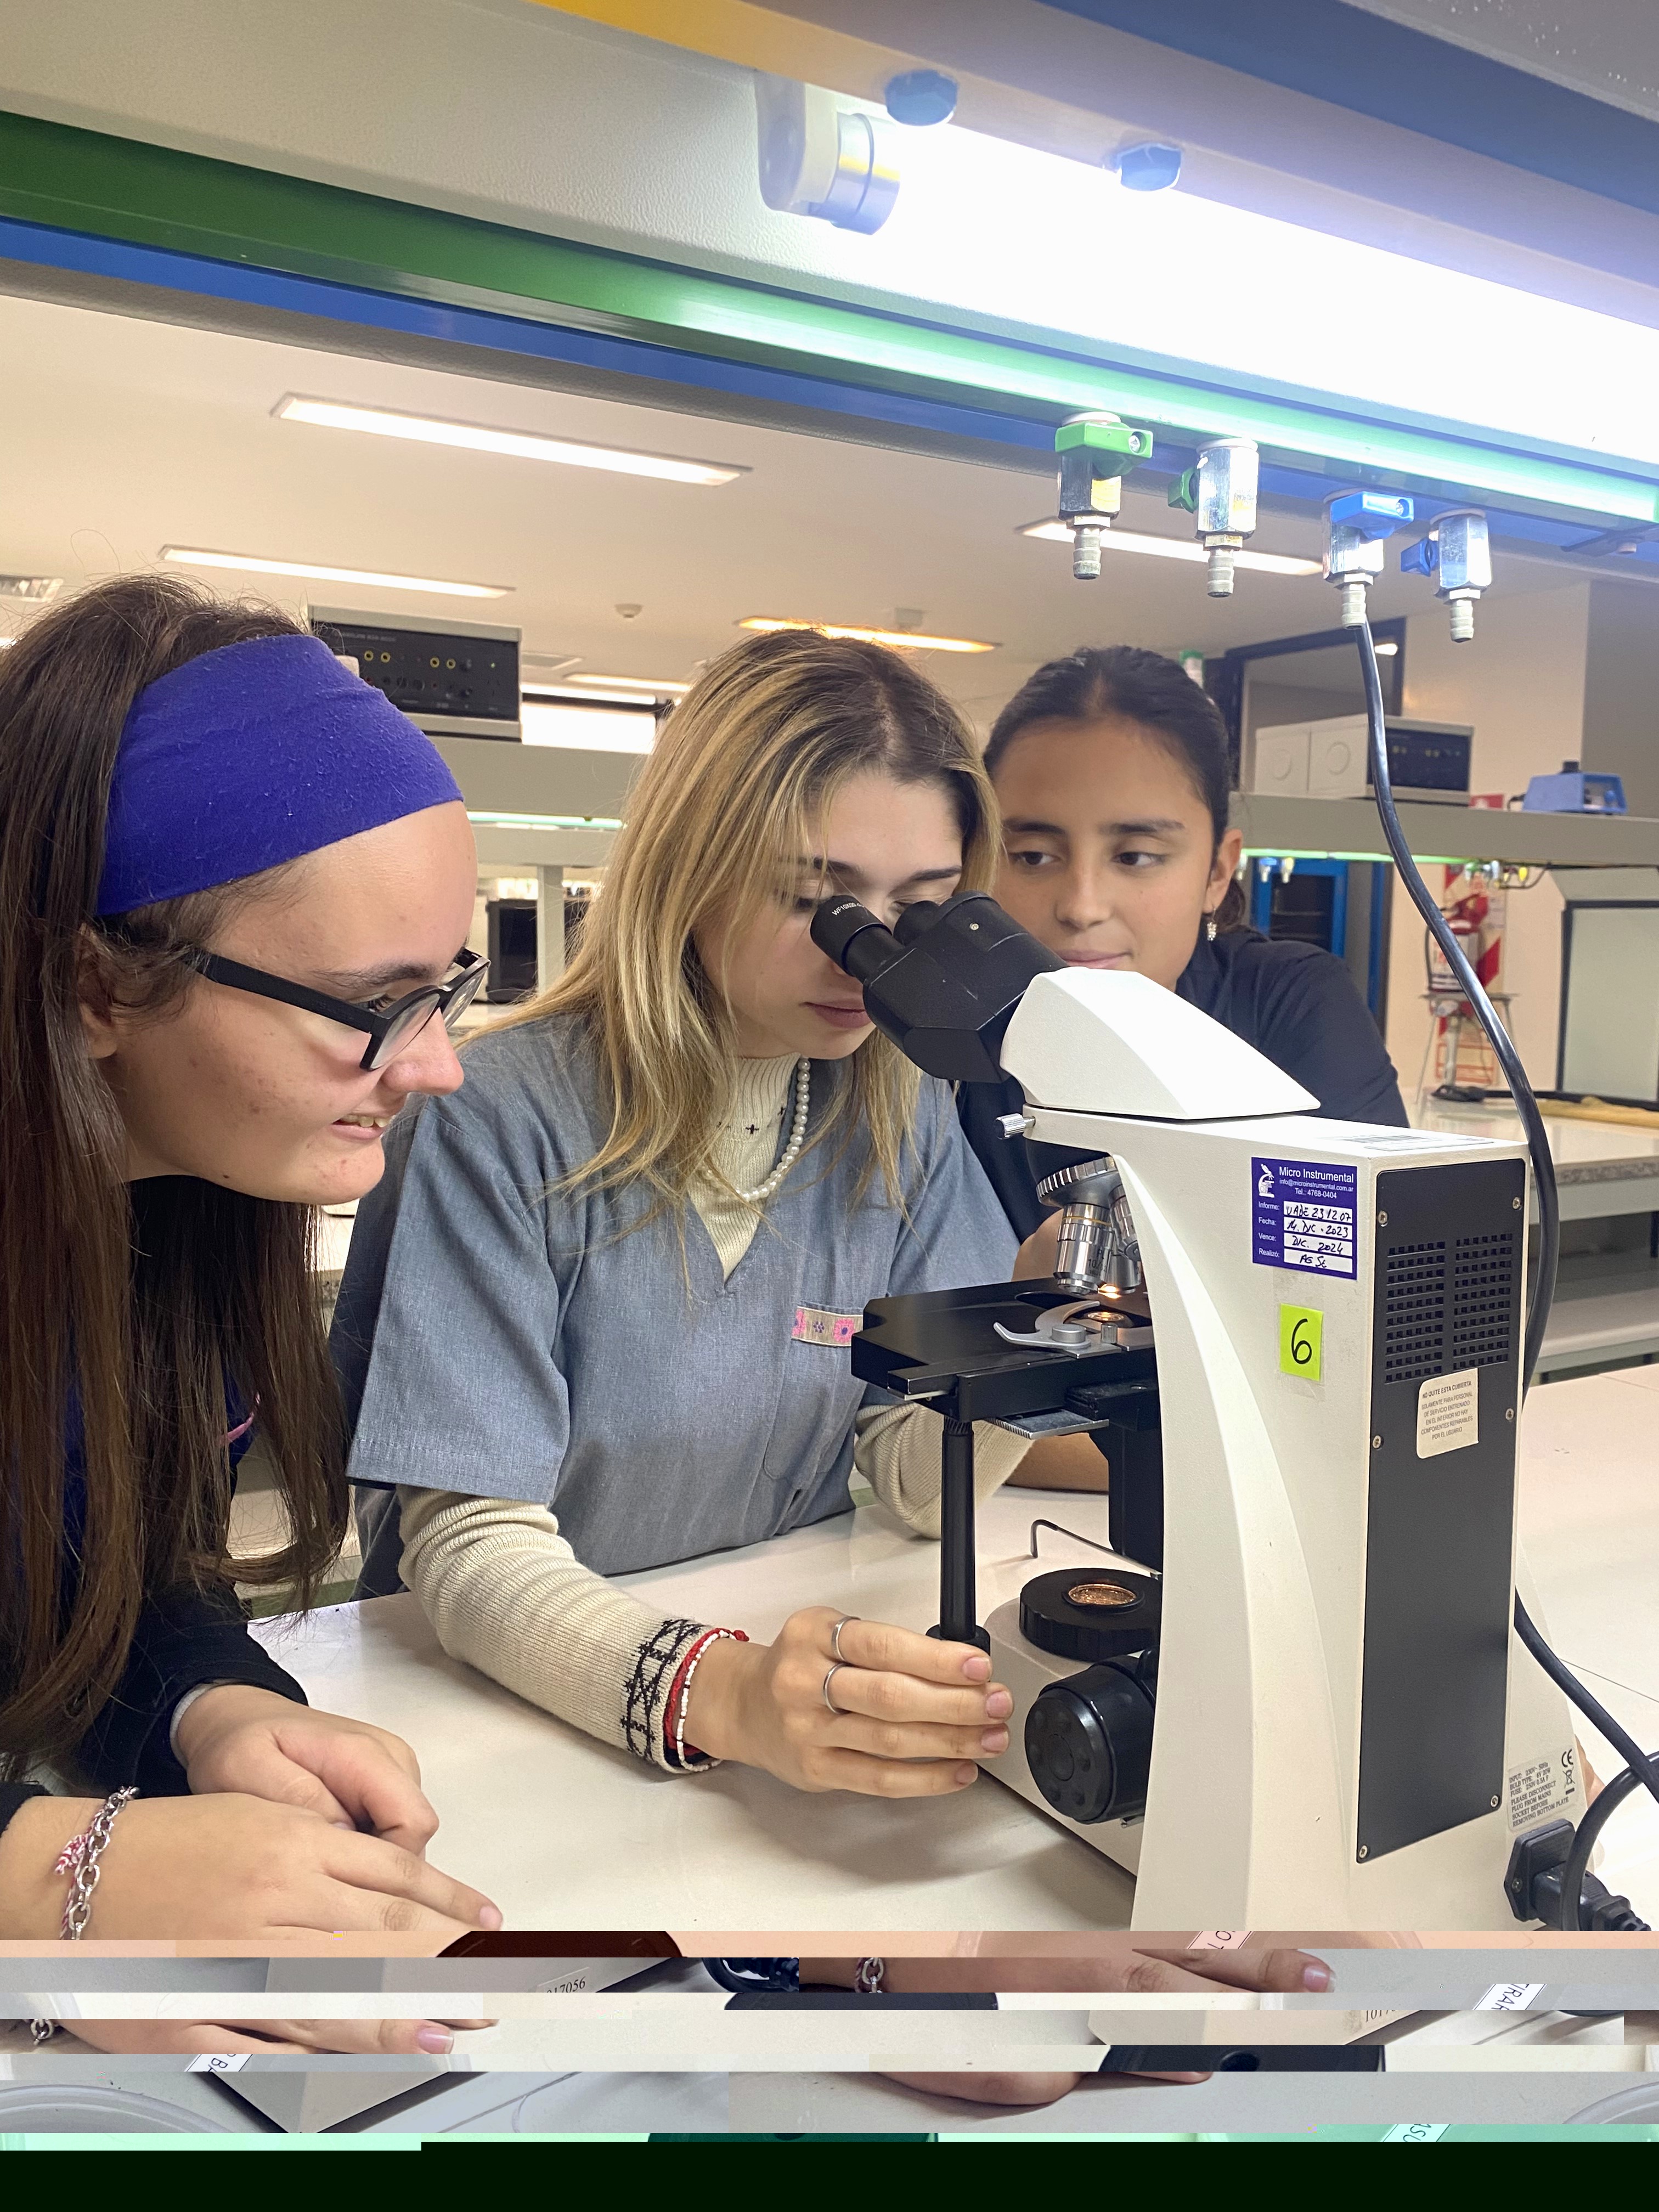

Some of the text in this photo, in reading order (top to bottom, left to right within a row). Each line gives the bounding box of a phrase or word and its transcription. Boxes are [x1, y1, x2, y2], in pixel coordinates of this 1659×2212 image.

[1279, 1166, 1353, 1183] Micro Instrumental
[1279, 1179, 1353, 1192] info@microinstrumental.com.ar
[1307, 1190, 1336, 1199] 4768-0404
[1259, 1201, 1280, 1210] Informe:
[1259, 1217, 1276, 1226] Fecha:
[1259, 1233, 1276, 1241] Vence:
[1325, 1226, 1348, 1238] 2023
[1292, 1235, 1344, 1255] DIC. 2024
[1259, 1248, 1279, 1257] Realizó:
[1291, 1318, 1312, 1364] 6
[1429, 1389, 1441, 1397] QUITE
[1452, 1380, 1472, 1390] CUBIERTA
[1430, 1407, 1447, 1416] SERVICIO
[1561, 1748, 1573, 1768] CE
[1509, 1773, 1522, 1782] INPUT:
[1510, 1781, 1521, 1790] BULB
[1510, 1788, 1522, 1797] FUSE:
[1511, 1780, 1556, 1805] PLEASE DISCONNECT
[1511, 1790, 1552, 1813] PLUG FROM MAINS
[1512, 1799, 1548, 1820] SOCKET BEFORE
[1513, 1797, 1569, 1827] REMOVING BOTTOM PLATE
